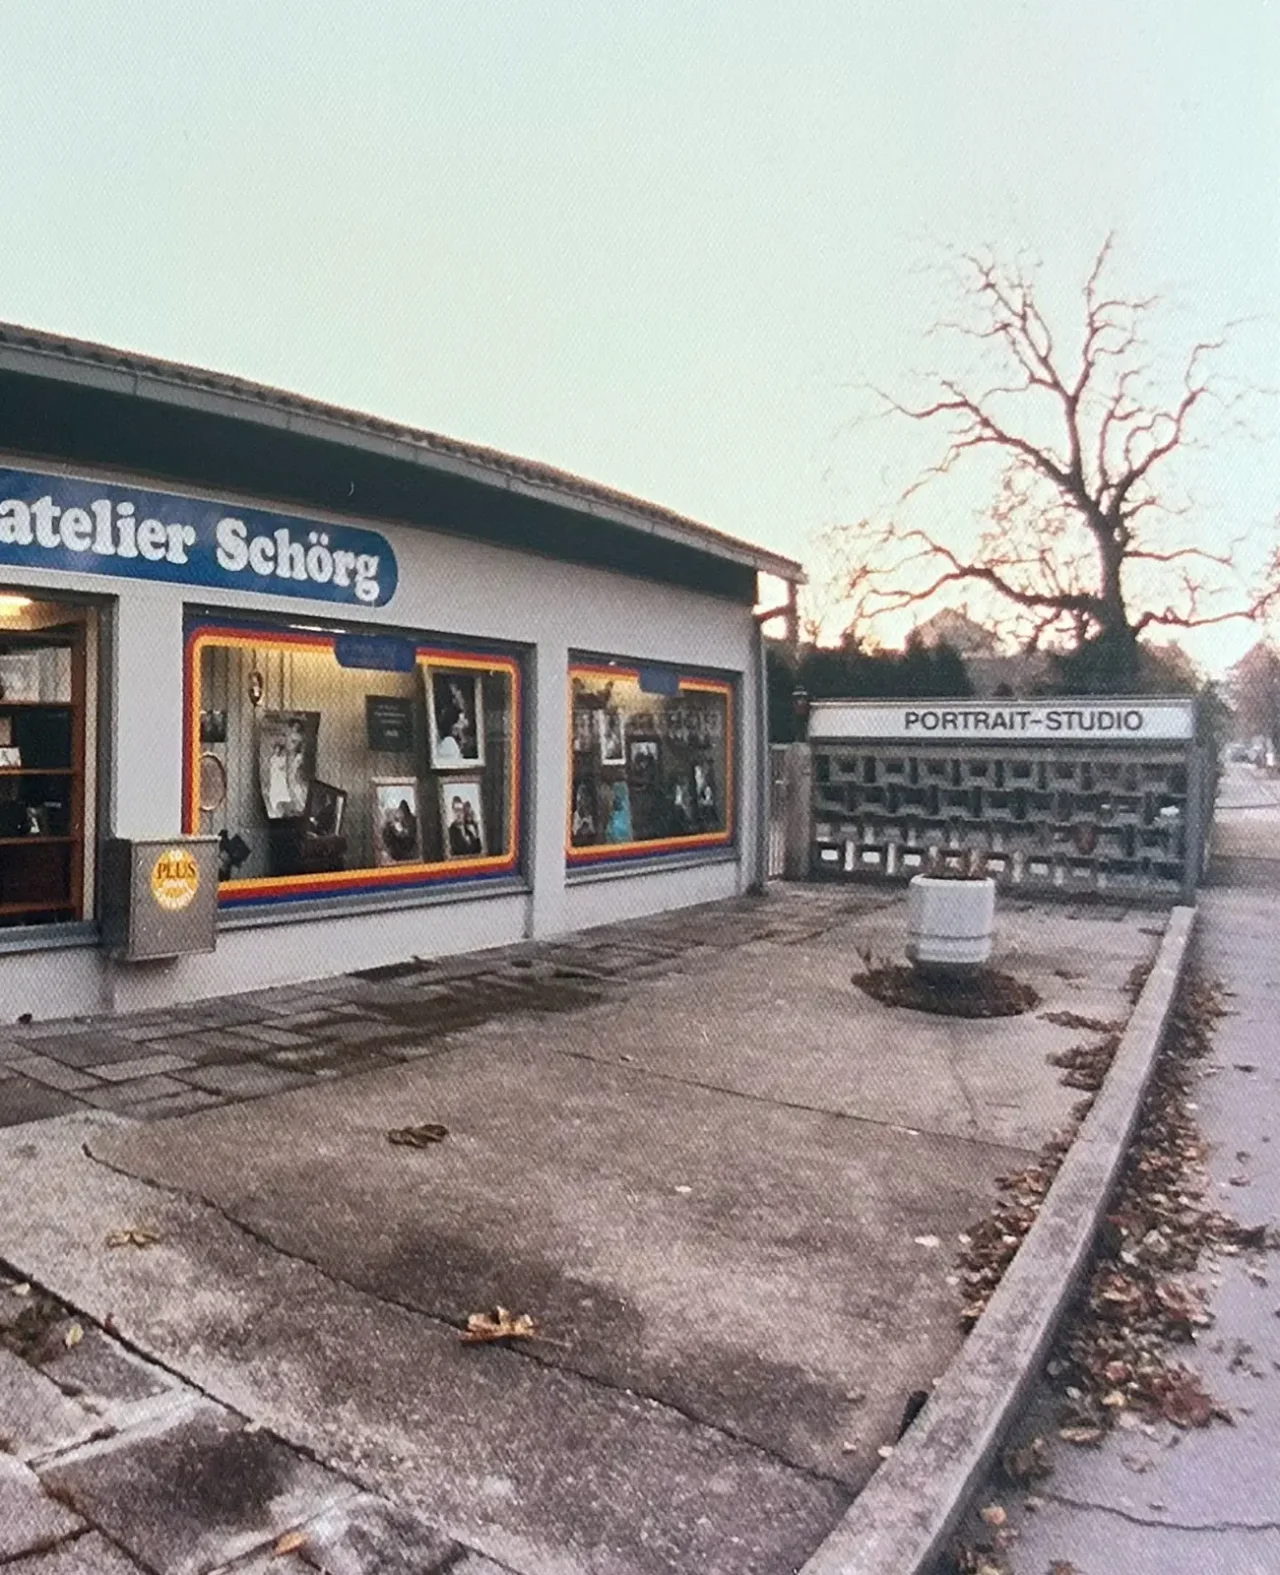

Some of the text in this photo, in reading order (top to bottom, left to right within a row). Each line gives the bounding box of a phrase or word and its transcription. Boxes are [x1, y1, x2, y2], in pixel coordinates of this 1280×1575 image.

[215, 517, 380, 602] Schörg
[904, 710, 1144, 731] PORTRAIT-STUDIO
[156, 861, 197, 880] PLUS
